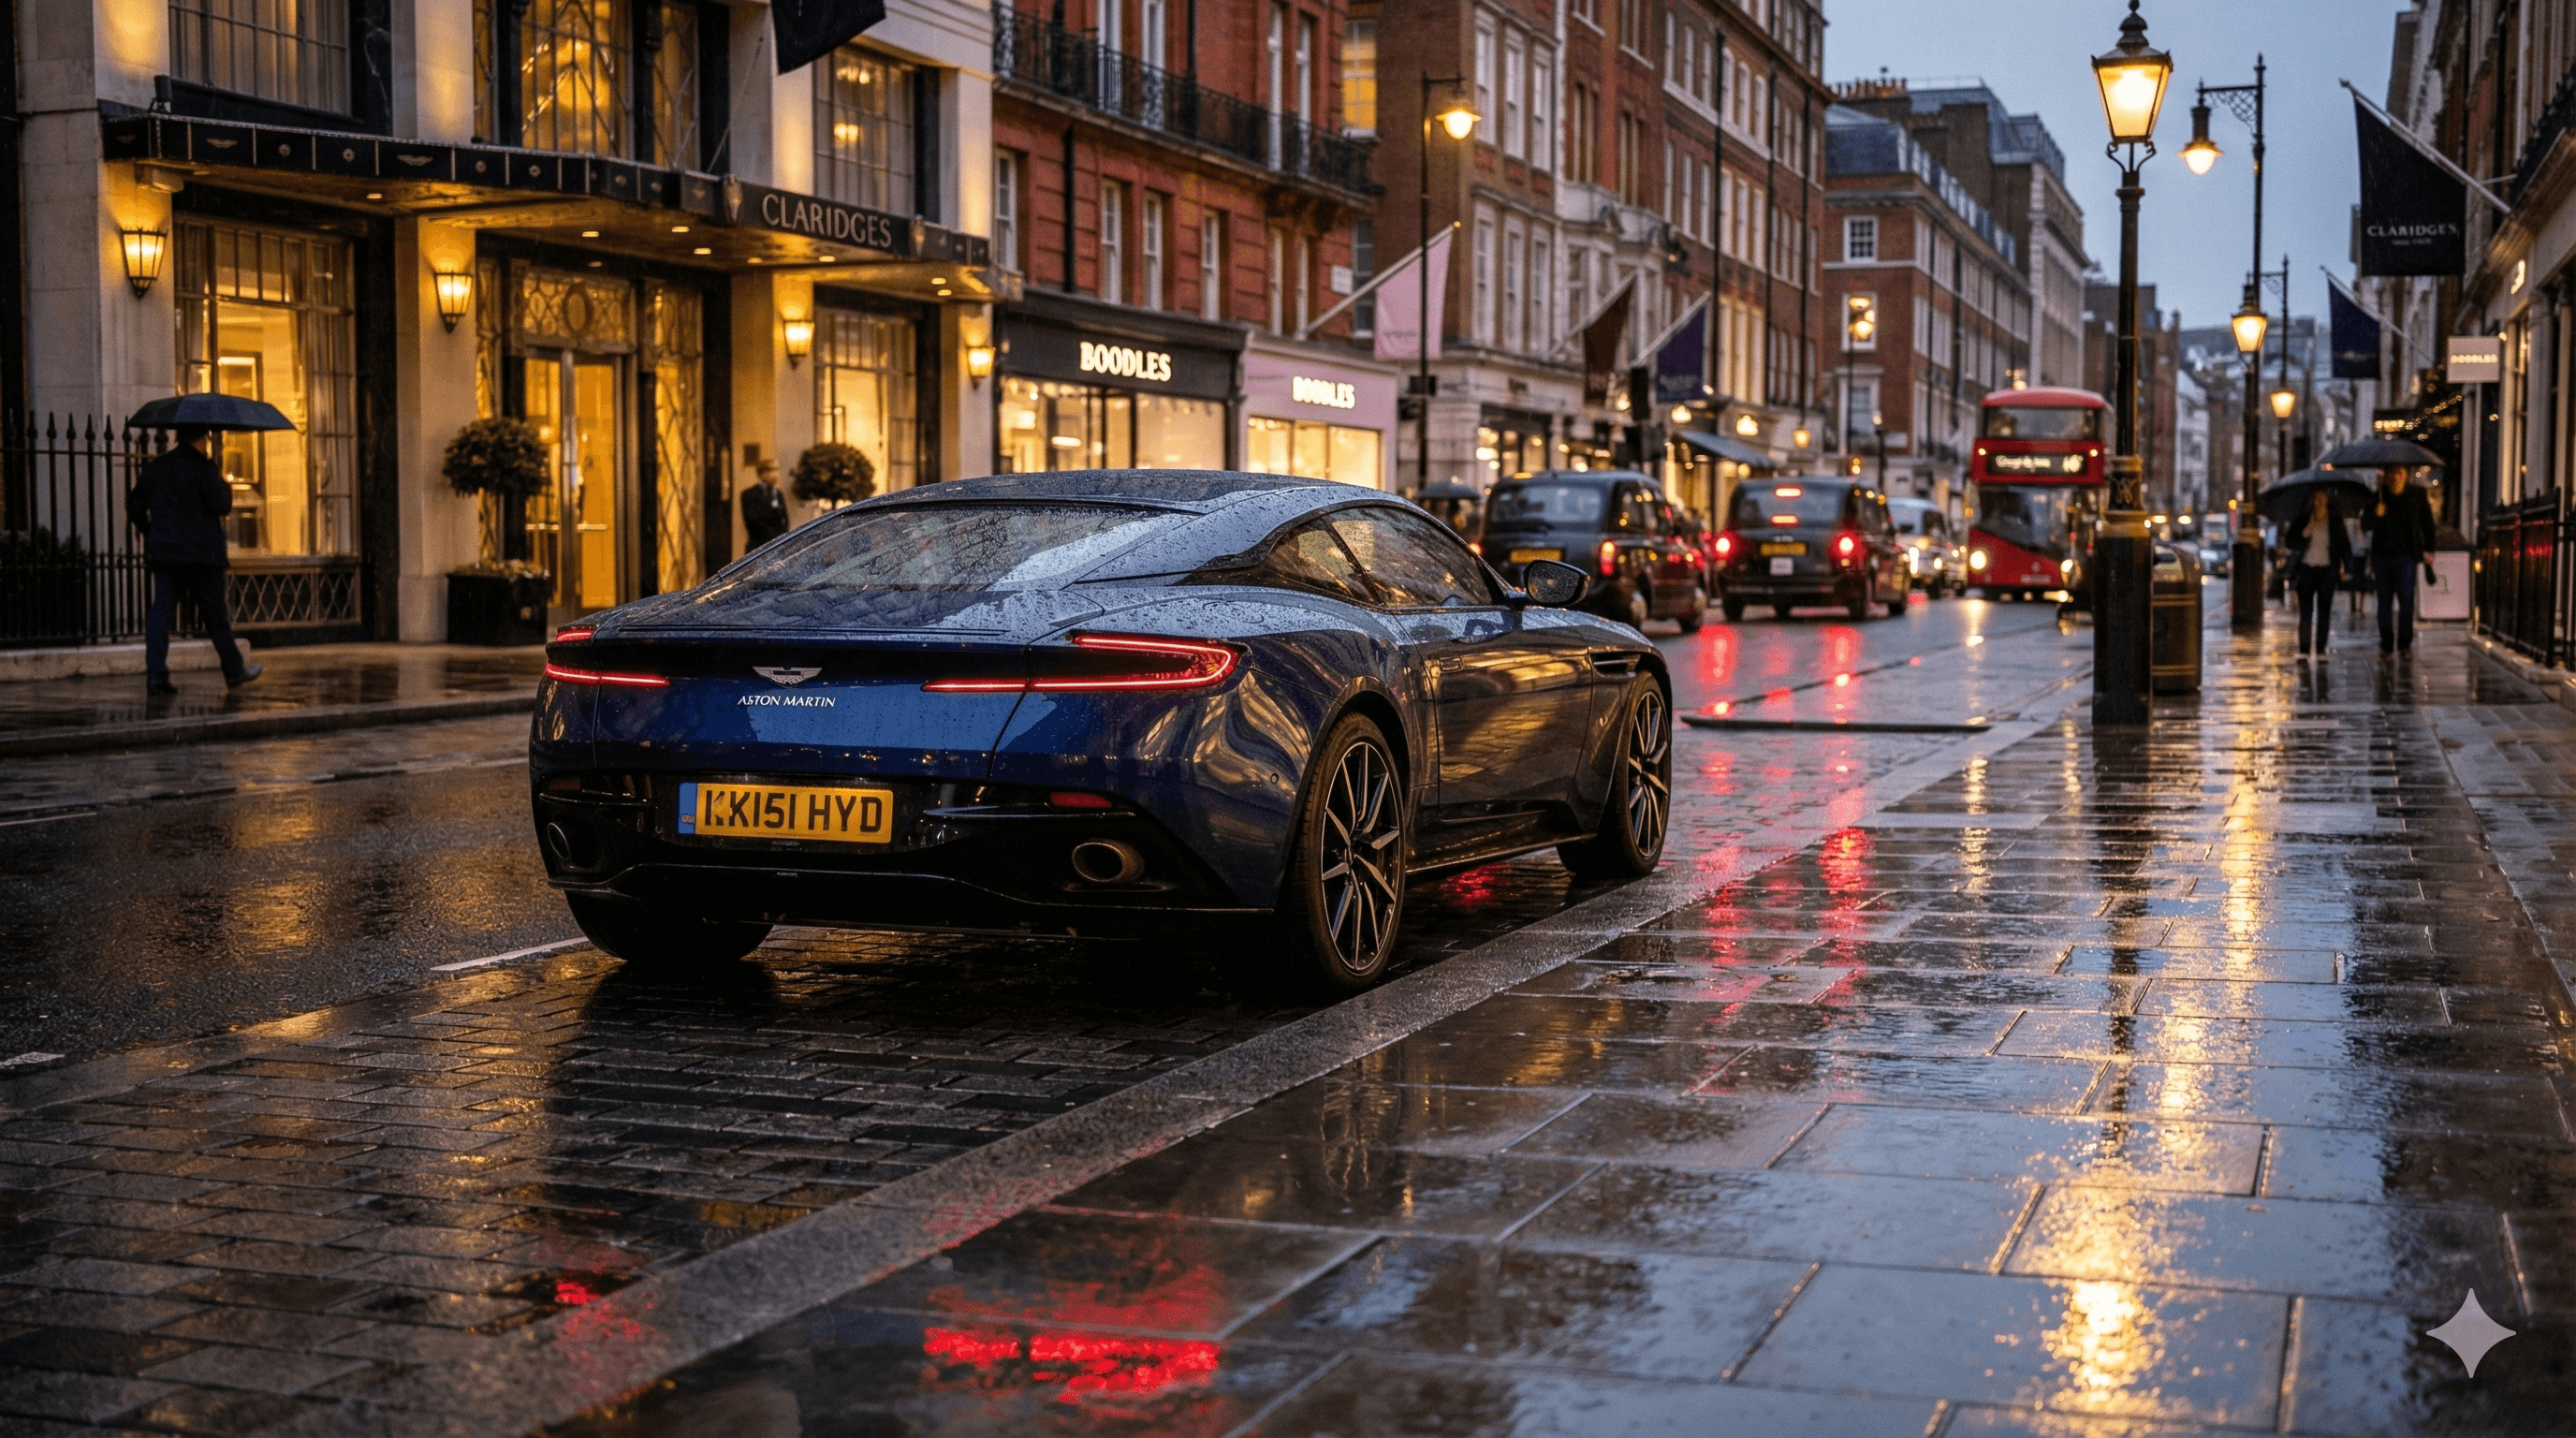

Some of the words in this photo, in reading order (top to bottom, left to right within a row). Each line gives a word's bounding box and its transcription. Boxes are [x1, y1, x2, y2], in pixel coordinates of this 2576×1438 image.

[762, 193, 892, 248] CLARIDGES
[1079, 341, 1172, 382] BOODLES
[737, 695, 782, 706] ASTON
[783, 696, 837, 708] MARTIN
[808, 794, 883, 833] HYD
